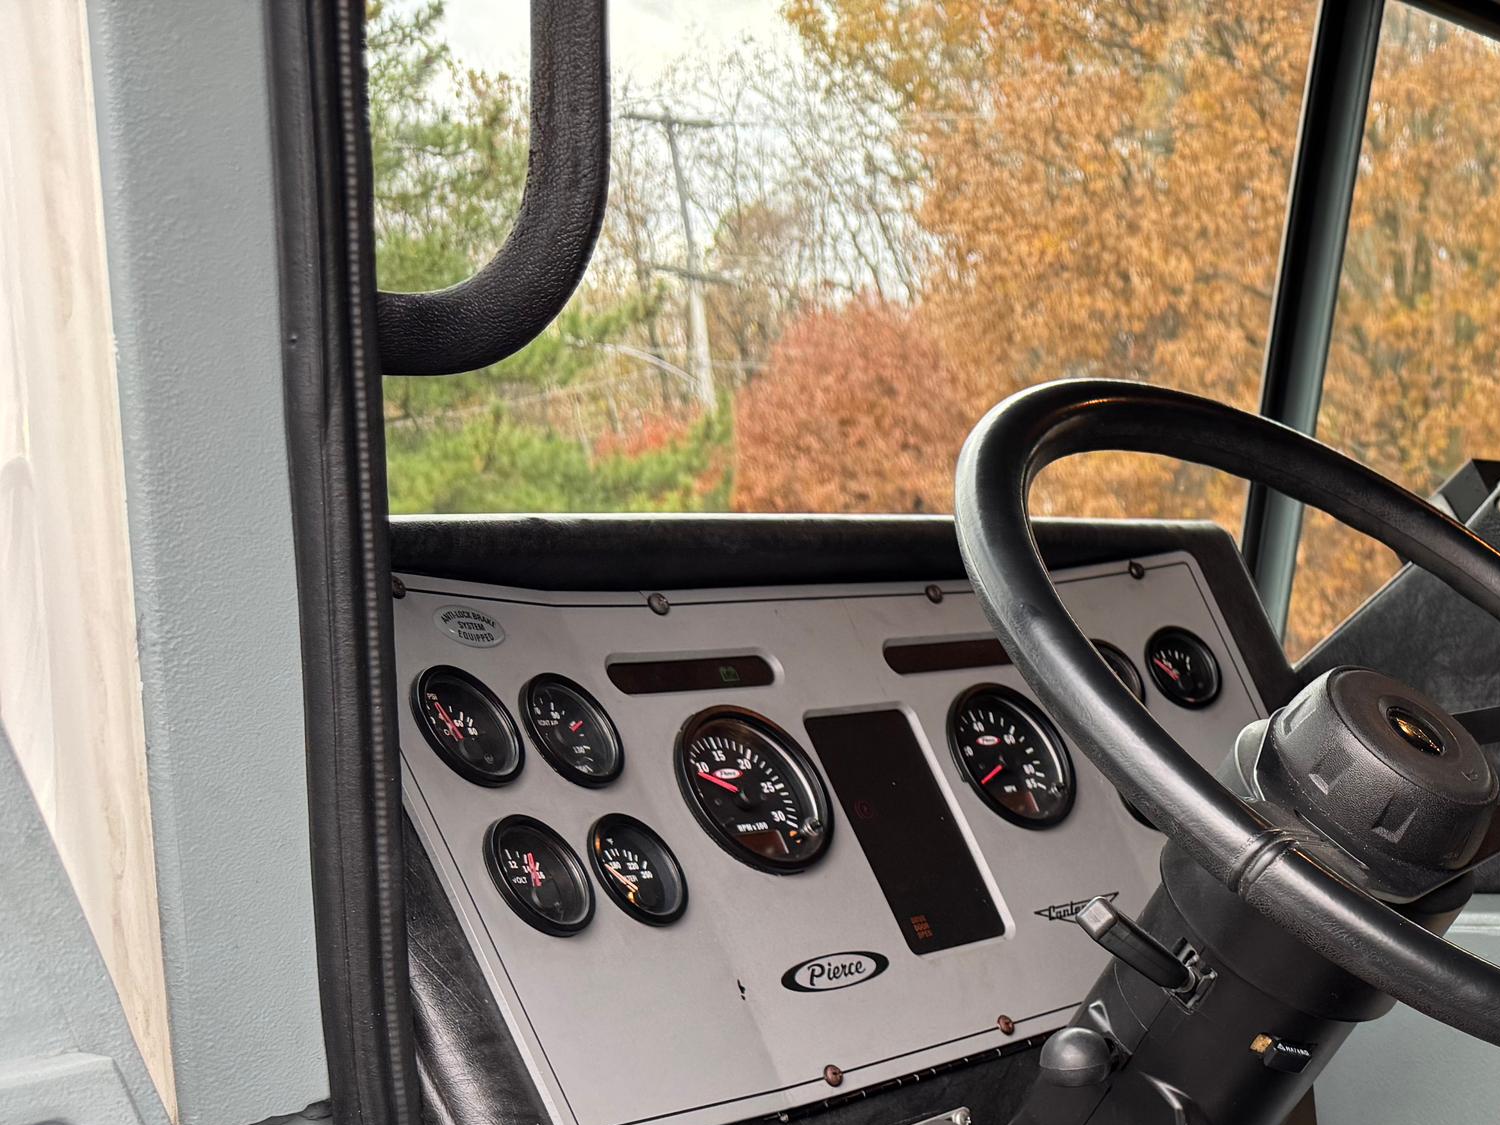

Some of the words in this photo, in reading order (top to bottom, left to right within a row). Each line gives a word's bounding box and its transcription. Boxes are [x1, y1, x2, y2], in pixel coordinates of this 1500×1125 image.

[457, 620, 486, 631] SYSTEM
[457, 629, 495, 642] EQUIPPED
[712, 750, 727, 762] 15
[696, 761, 710, 774] 10
[737, 758, 752, 770] 20
[760, 781, 776, 794] 25
[771, 810, 786, 822] 30
[737, 823, 752, 832] RPM
[807, 958, 867, 987] Pierce
